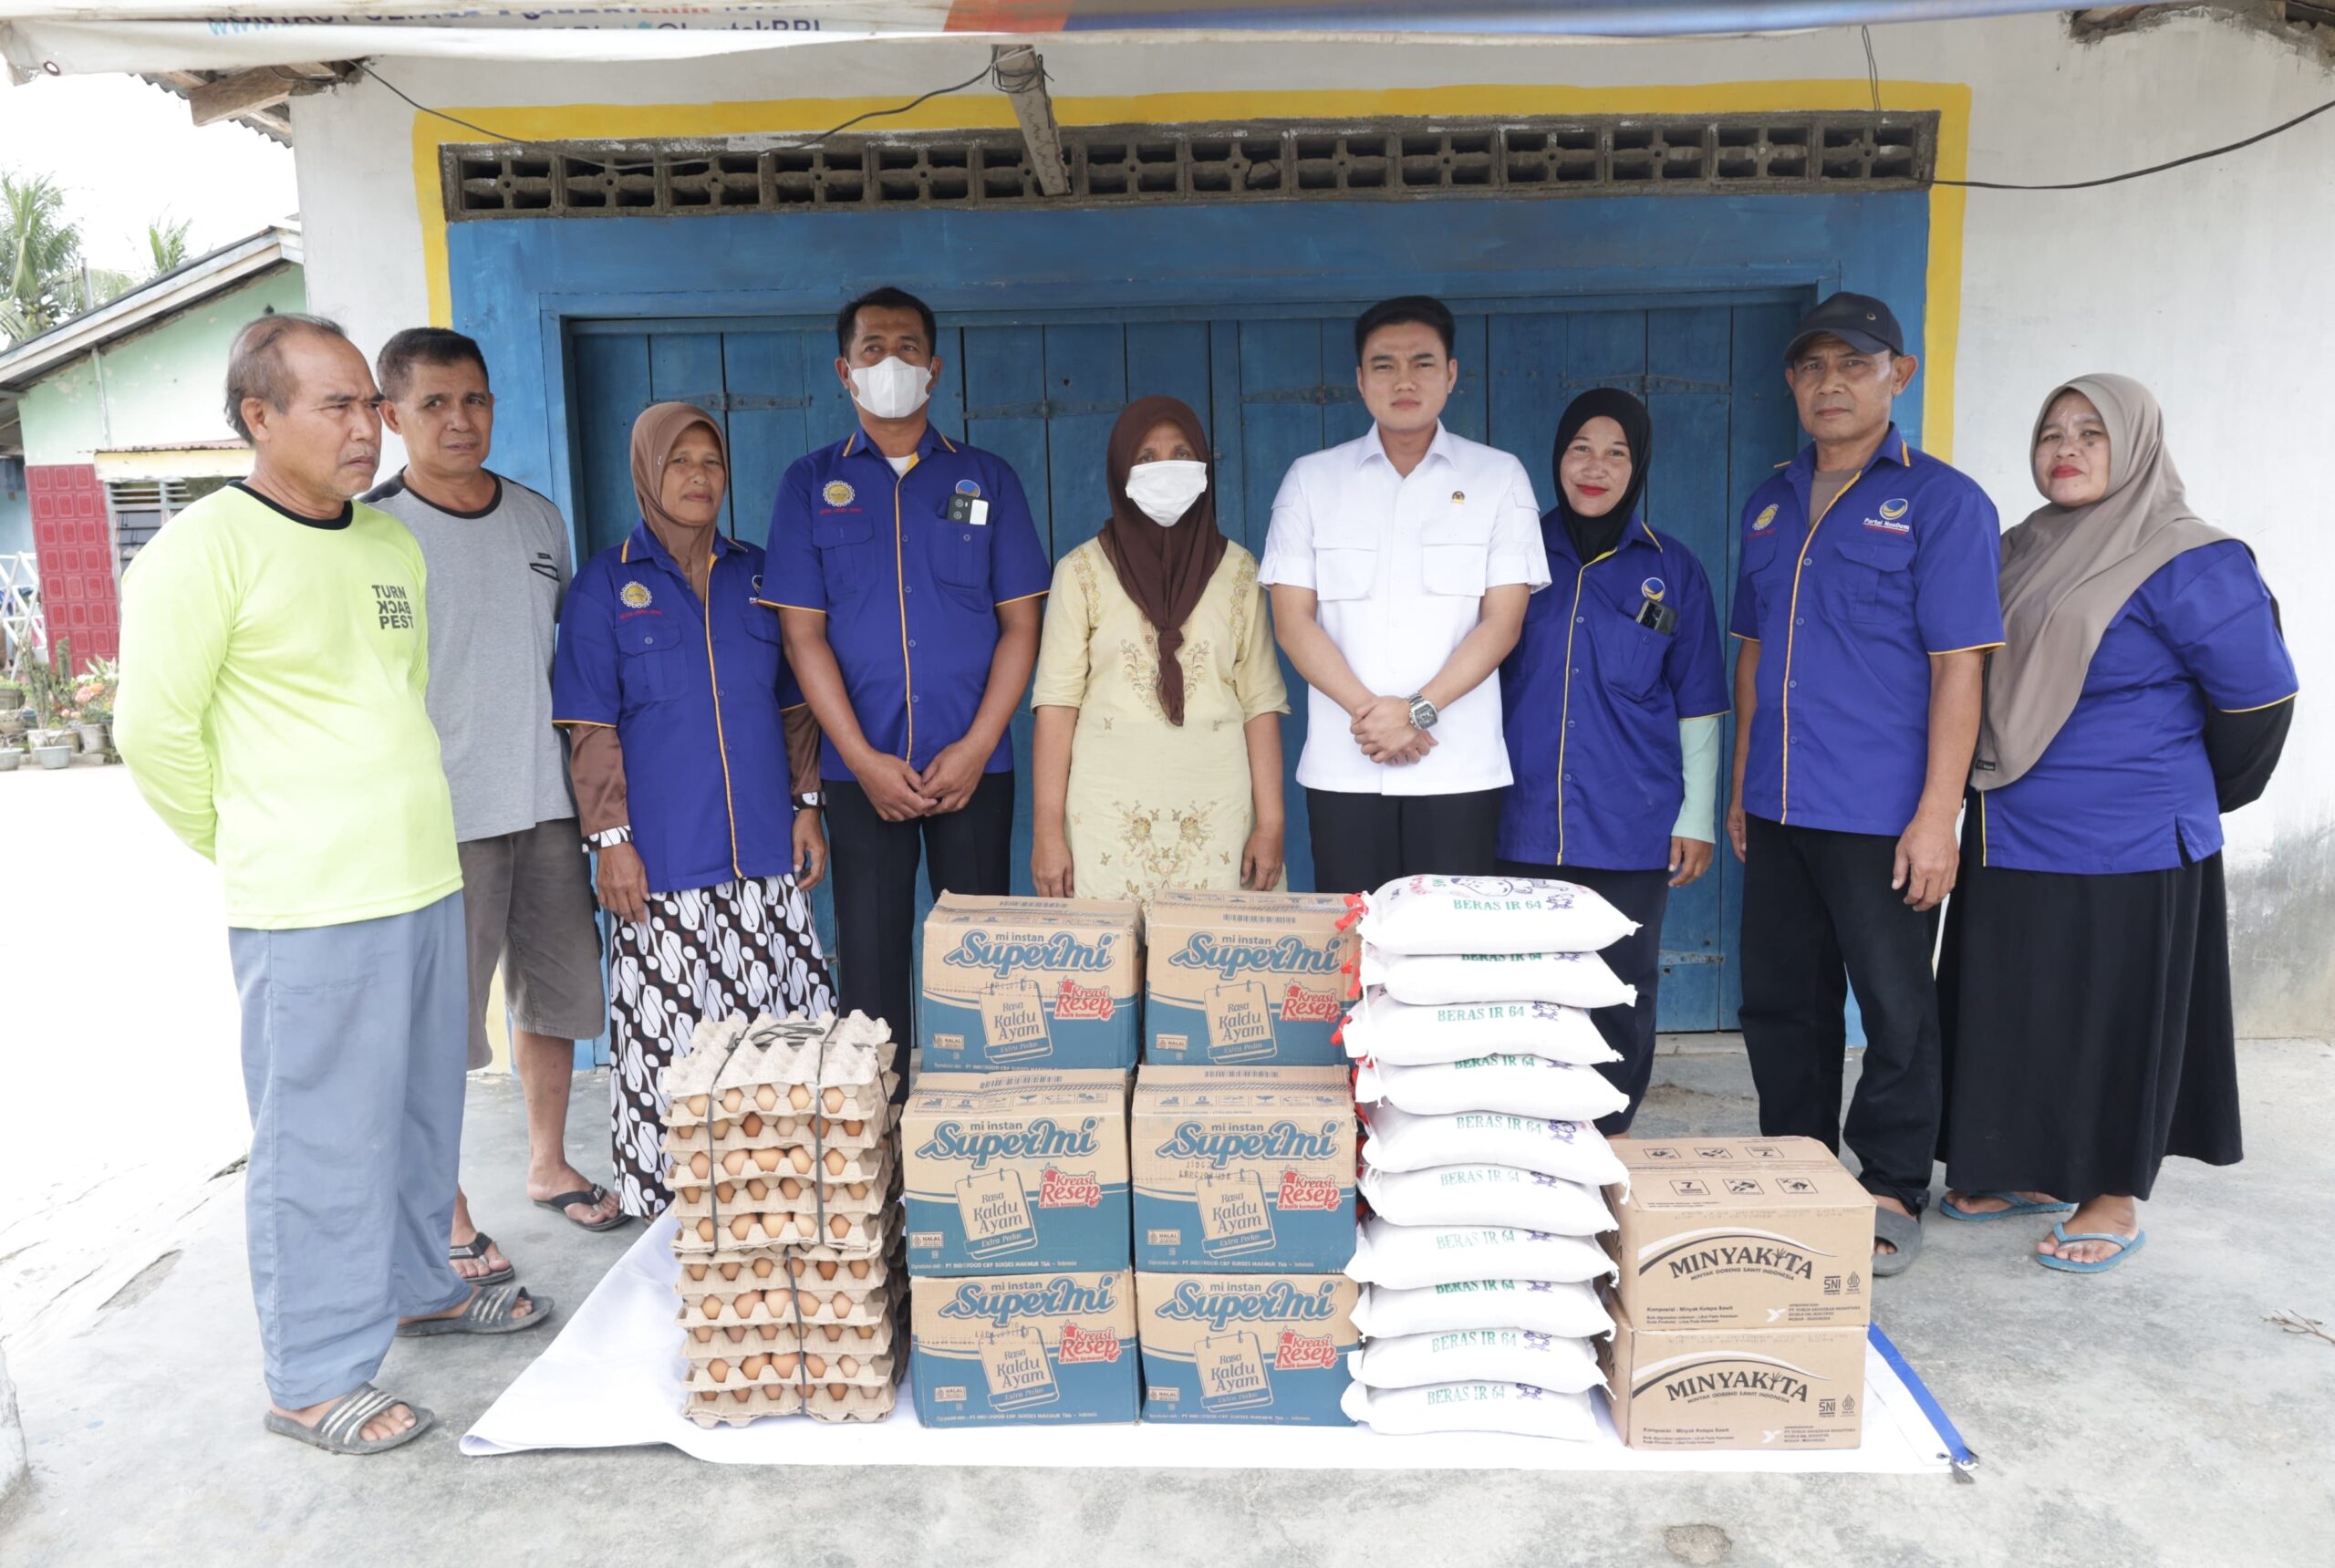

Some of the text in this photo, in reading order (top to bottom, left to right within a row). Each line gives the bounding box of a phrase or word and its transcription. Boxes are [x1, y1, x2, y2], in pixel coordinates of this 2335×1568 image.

[372, 585, 407, 599] TURN
[379, 615, 414, 629] PEST
[1453, 899, 1542, 910] BERAS IR 64
[996, 932, 1044, 942] mi instan
[1222, 936, 1271, 945] mi instan
[1072, 987, 1106, 998] Kreasi
[1299, 992, 1334, 1002] Kreasi
[1002, 1002, 1023, 1012] Rasa
[1056, 994, 1112, 1014] Resep
[1228, 1003, 1250, 1012] Rasa
[1282, 999, 1338, 1019] Resep
[994, 1012, 1036, 1029] Kaldu
[1219, 1013, 1261, 1029] Kaldu
[1437, 1006, 1524, 1023] BERAS IR 64
[999, 1026, 1039, 1042] Ayam
[1222, 1027, 1264, 1042] Ayam
[1454, 1056, 1535, 1070] BERAS IR 64
[970, 1121, 1022, 1131] mi instan
[1211, 1124, 1264, 1132] mi instan
[1457, 1116, 1542, 1134] BERAS IR 64
[1056, 1175, 1094, 1186] Kreasi
[1296, 1178, 1333, 1188] Kreasi
[1440, 1169, 1520, 1187] BERAS IR 64
[981, 1192, 1004, 1204] Rasa
[1041, 1184, 1099, 1202] Resep
[1221, 1191, 1244, 1204] Rasa
[1279, 1185, 1338, 1206] Resep
[973, 1202, 1018, 1221] Kaldu
[1212, 1203, 1258, 1221] Kaldu
[979, 1215, 1023, 1234] Ayam
[1218, 1216, 1262, 1234] Ayam
[1437, 1230, 1515, 1250] BERAS IR 64
[1691, 1271, 1714, 1281] MINYAK
[1762, 1269, 1795, 1281] INDONESIA
[991, 1280, 1043, 1291] mi instan
[1210, 1282, 1261, 1293] mi instan
[1436, 1279, 1515, 1294] BERAS IR 64
[1824, 1279, 1841, 1290] SNI
[1075, 1329, 1111, 1341] Kreasi
[1293, 1336, 1329, 1347] Kreasi
[1432, 1332, 1517, 1352] BERAS IR 64
[1004, 1348, 1026, 1360] Rasa
[1060, 1339, 1117, 1357] Resep
[1277, 1345, 1334, 1364] Resep
[1219, 1353, 1242, 1365] Rasa
[996, 1359, 1041, 1378] Kaldu
[1211, 1364, 1255, 1381] Kaldu
[1002, 1371, 1045, 1389] Ayam
[1216, 1376, 1260, 1393] Ayam
[1427, 1385, 1505, 1405] BERAS IR 64
[1687, 1395, 1710, 1404] MINYAK
[1759, 1393, 1790, 1404] INDONESIA
[1819, 1401, 1836, 1412] SNI
